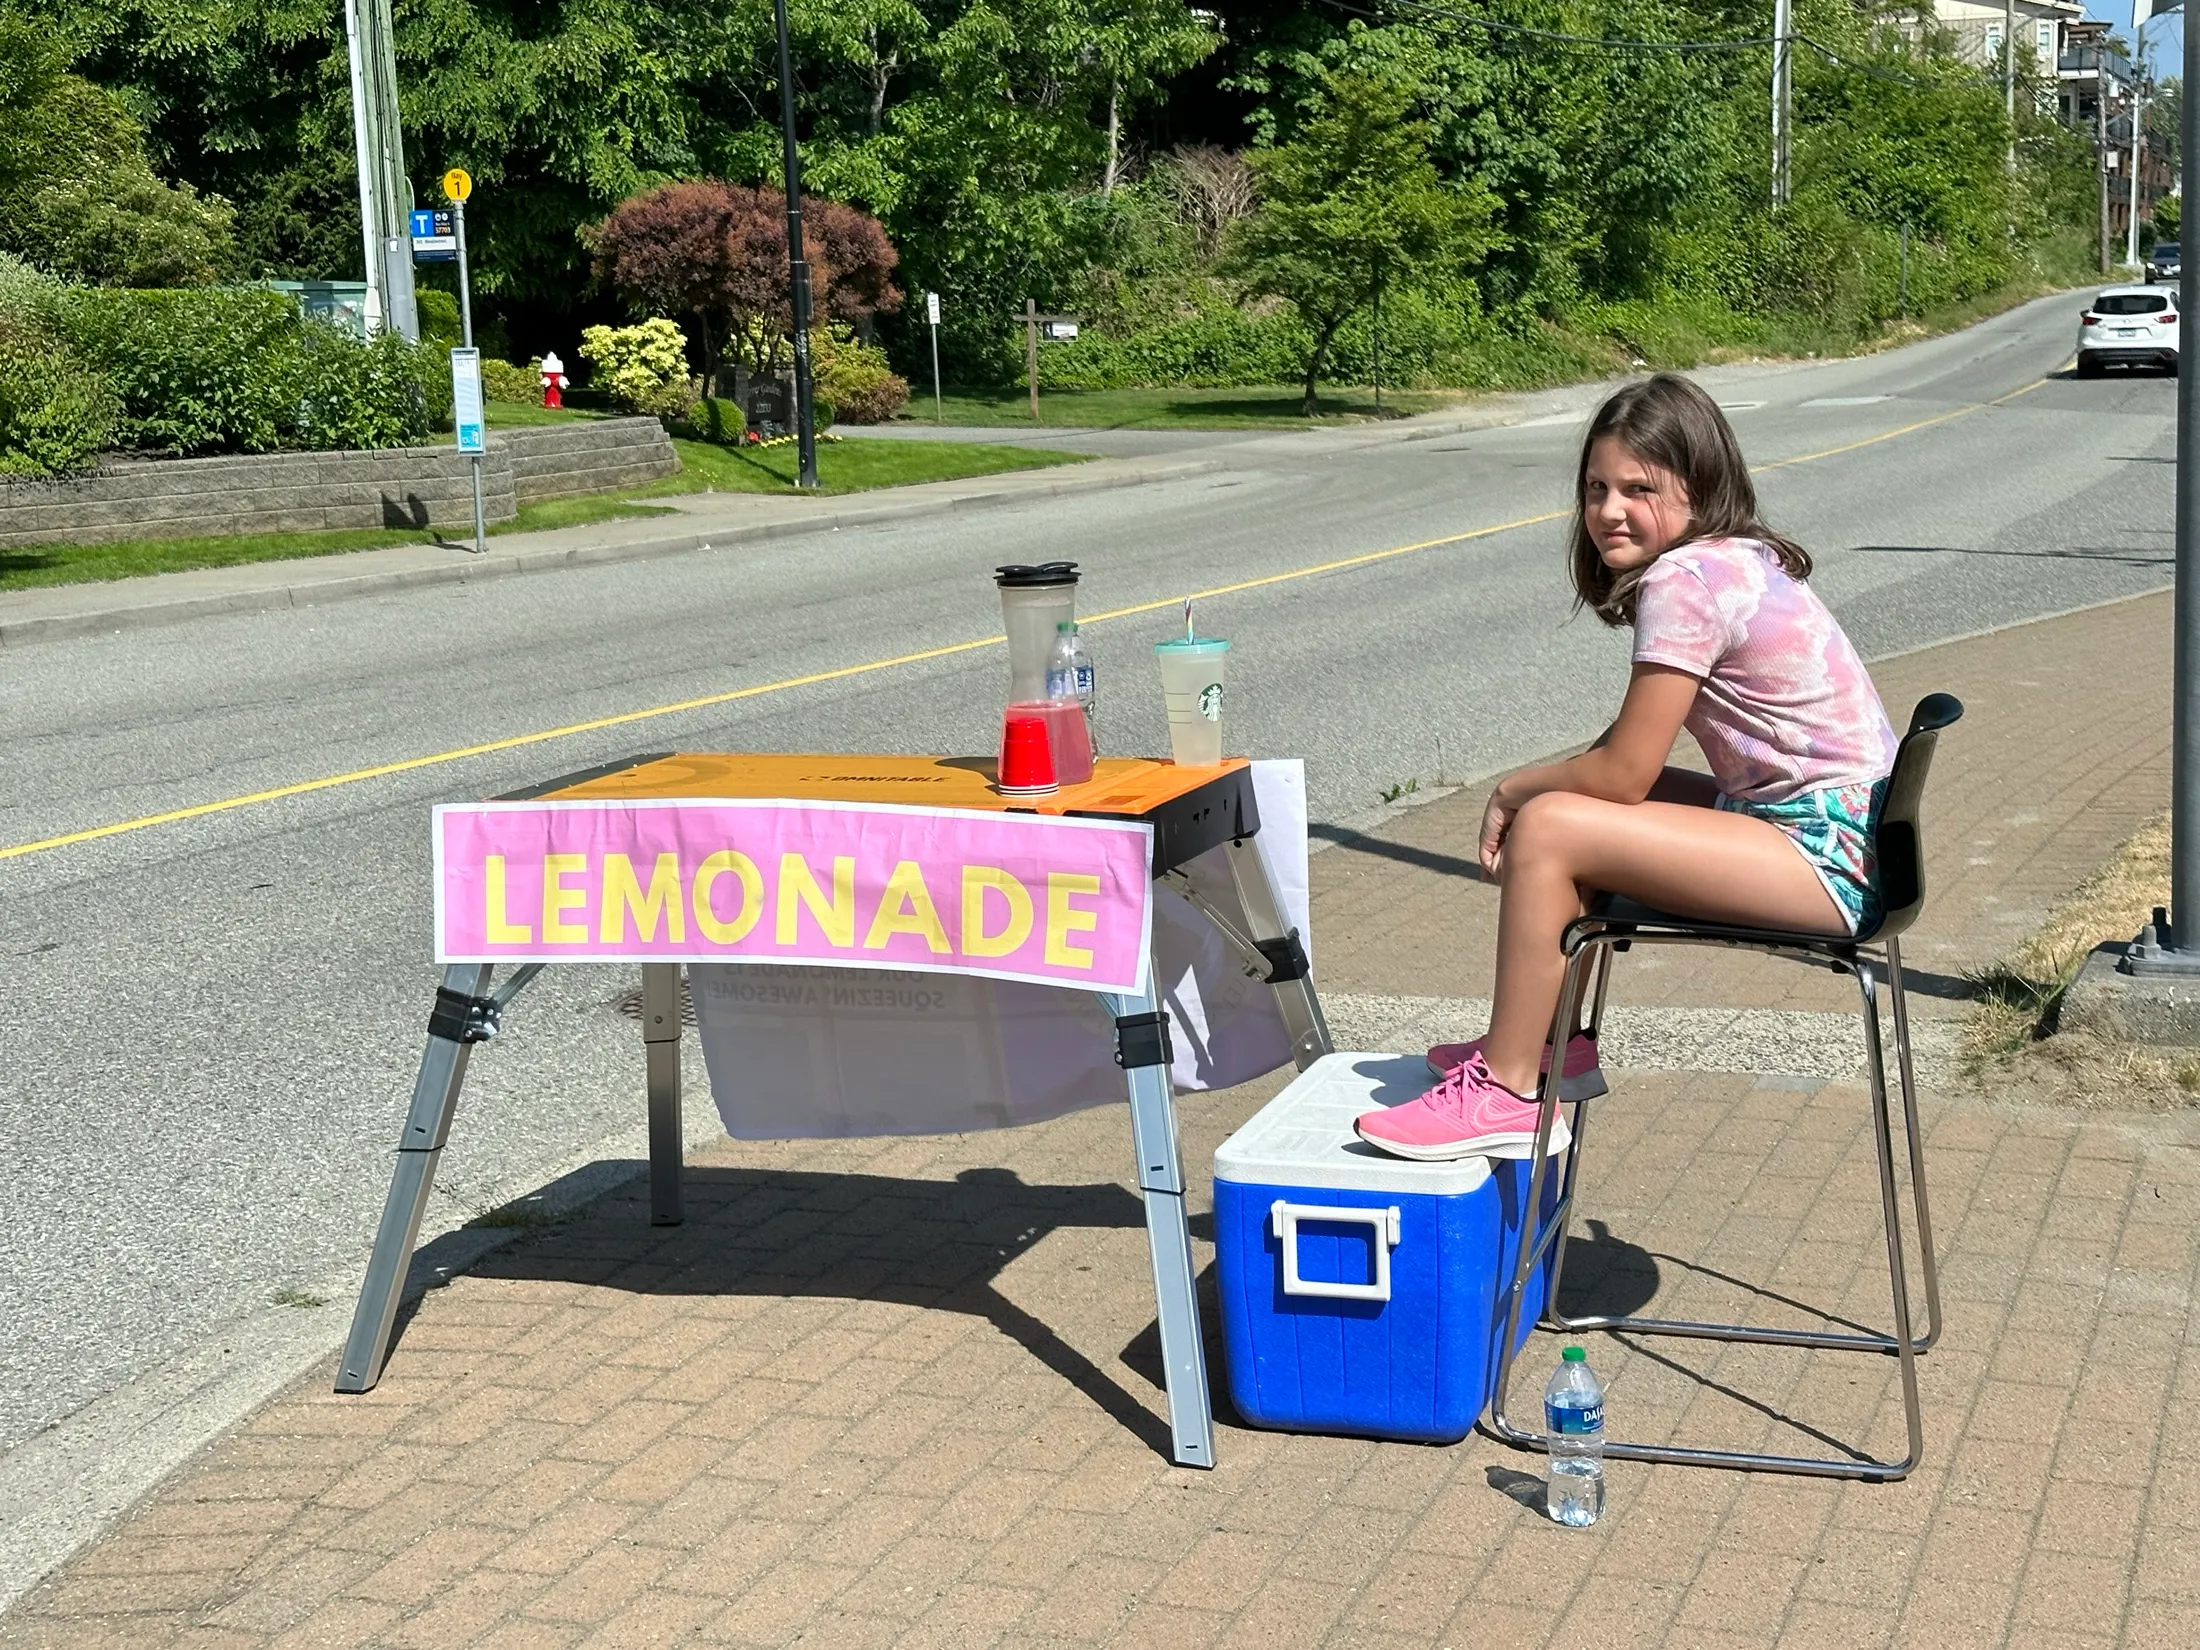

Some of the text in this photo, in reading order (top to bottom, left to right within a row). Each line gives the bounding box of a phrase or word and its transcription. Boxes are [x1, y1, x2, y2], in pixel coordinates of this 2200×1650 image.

[454, 181, 460, 196] 1
[415, 214, 428, 234] T
[485, 851, 1101, 969] LEMONADE
